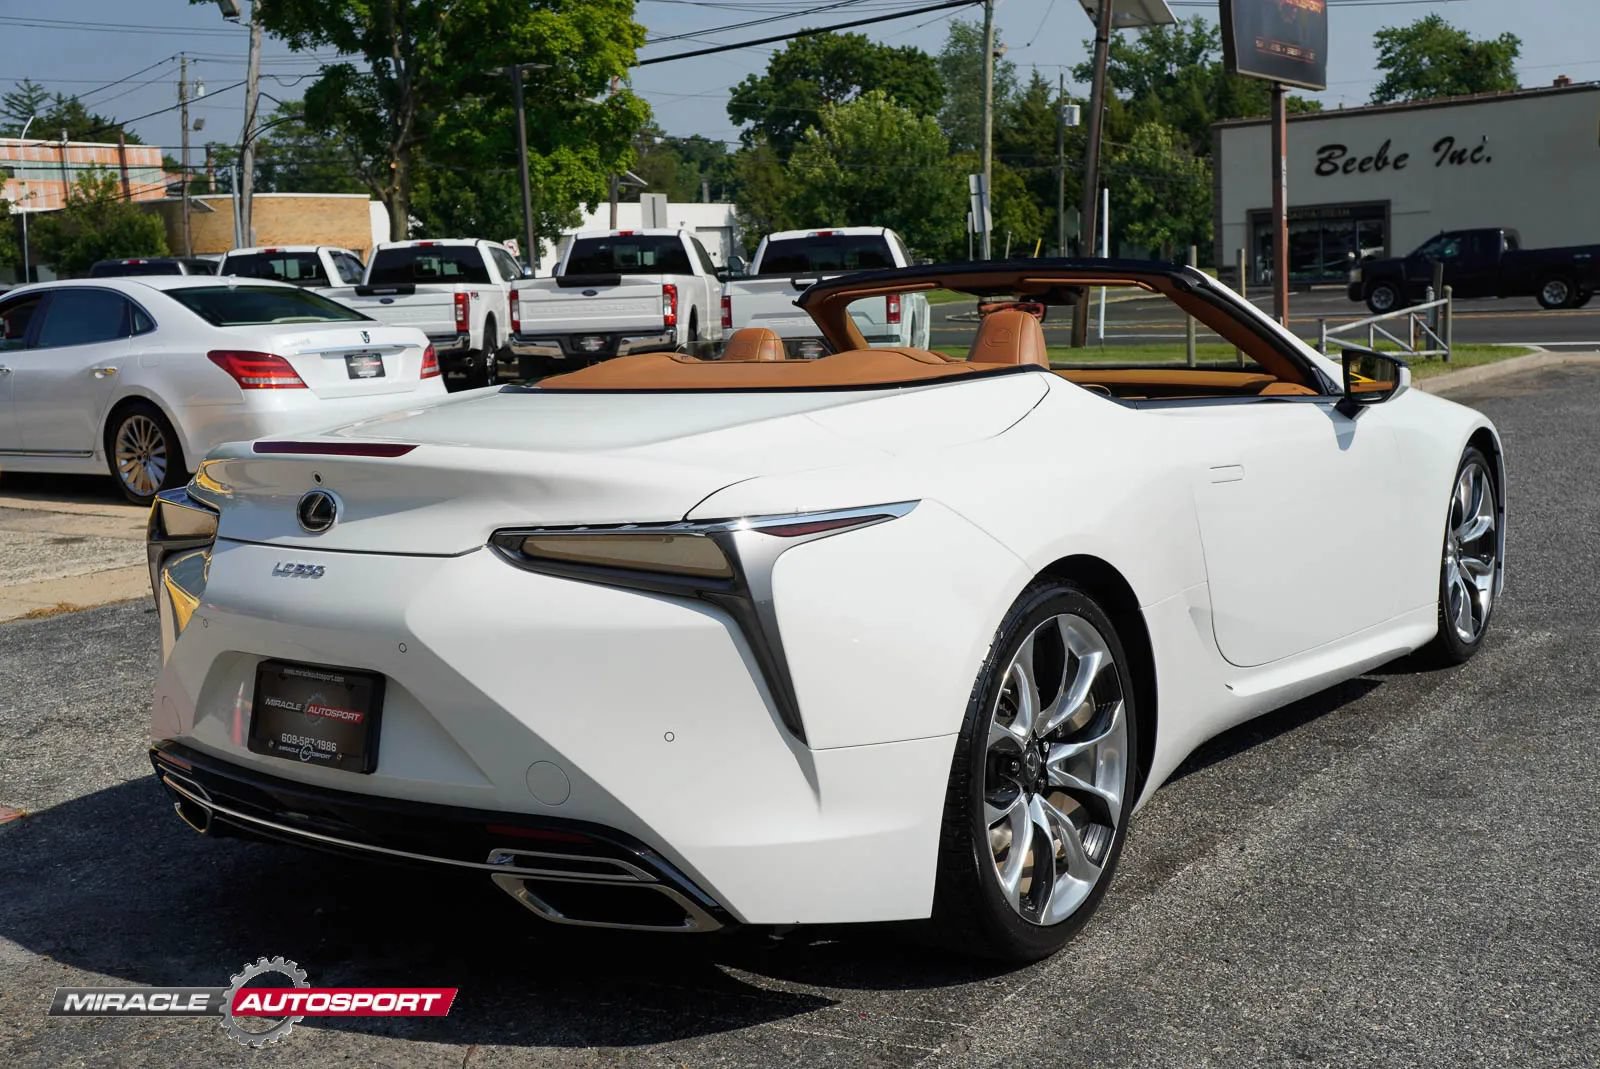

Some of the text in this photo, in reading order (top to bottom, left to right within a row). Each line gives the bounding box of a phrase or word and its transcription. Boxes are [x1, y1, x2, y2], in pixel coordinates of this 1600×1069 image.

[1315, 136, 1492, 177] Beebe Inc.
[265, 698, 360, 721] MIRACLE AUTOSPORT
